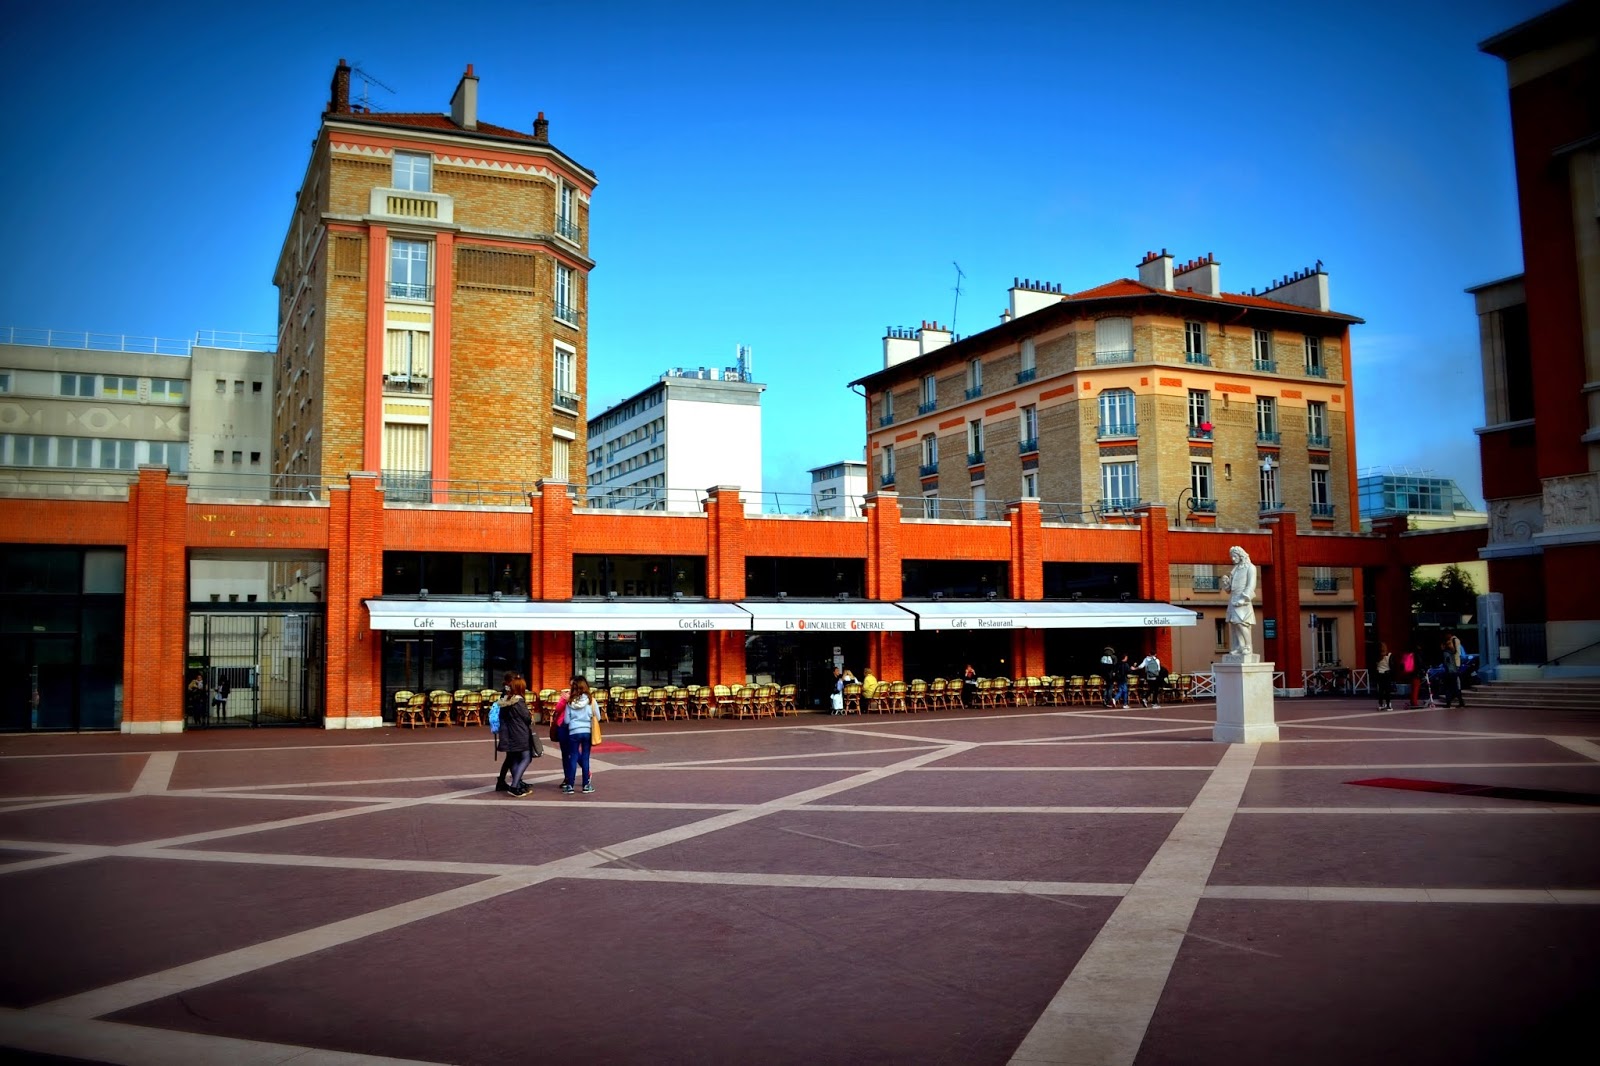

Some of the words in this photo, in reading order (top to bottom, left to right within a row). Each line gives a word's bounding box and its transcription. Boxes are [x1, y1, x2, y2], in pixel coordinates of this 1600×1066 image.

[413, 617, 434, 628] Café
[450, 618, 497, 628] Restaurant
[678, 618, 715, 629] Cocktails
[785, 620, 794, 629] LA
[850, 619, 885, 630] GENERALE
[951, 618, 967, 628] Café
[978, 618, 1013, 627] Restaurant
[1143, 616, 1170, 625] Cocktails
